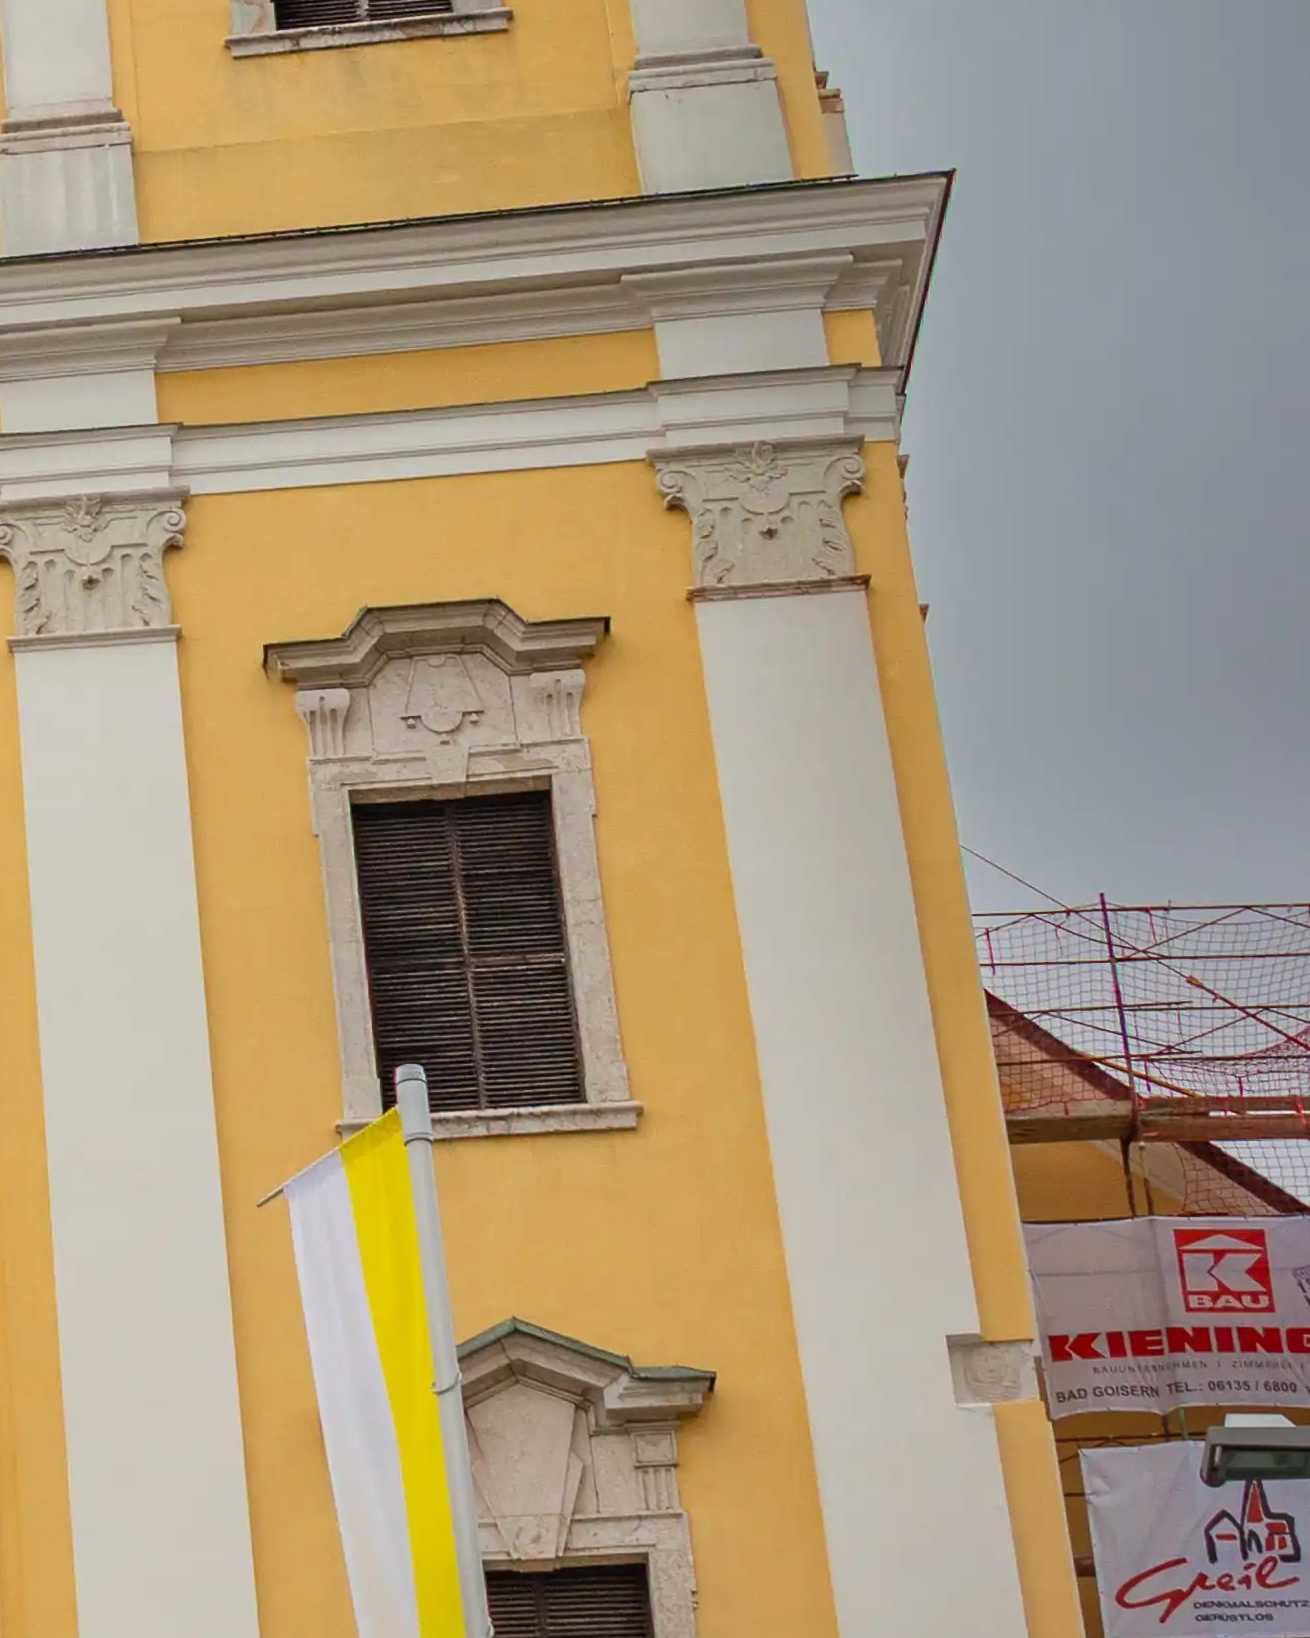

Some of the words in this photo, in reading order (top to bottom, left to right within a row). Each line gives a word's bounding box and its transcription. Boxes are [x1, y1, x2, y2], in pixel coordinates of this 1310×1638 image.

[1187, 1294, 1269, 1309] BAU
[1055, 1388, 1088, 1404] BAD
[1092, 1384, 1160, 1399] GOISERN
[1166, 1382, 1203, 1395] TEL.:
[1207, 1380, 1252, 1393] 06135
[1263, 1380, 1298, 1394] 6800
